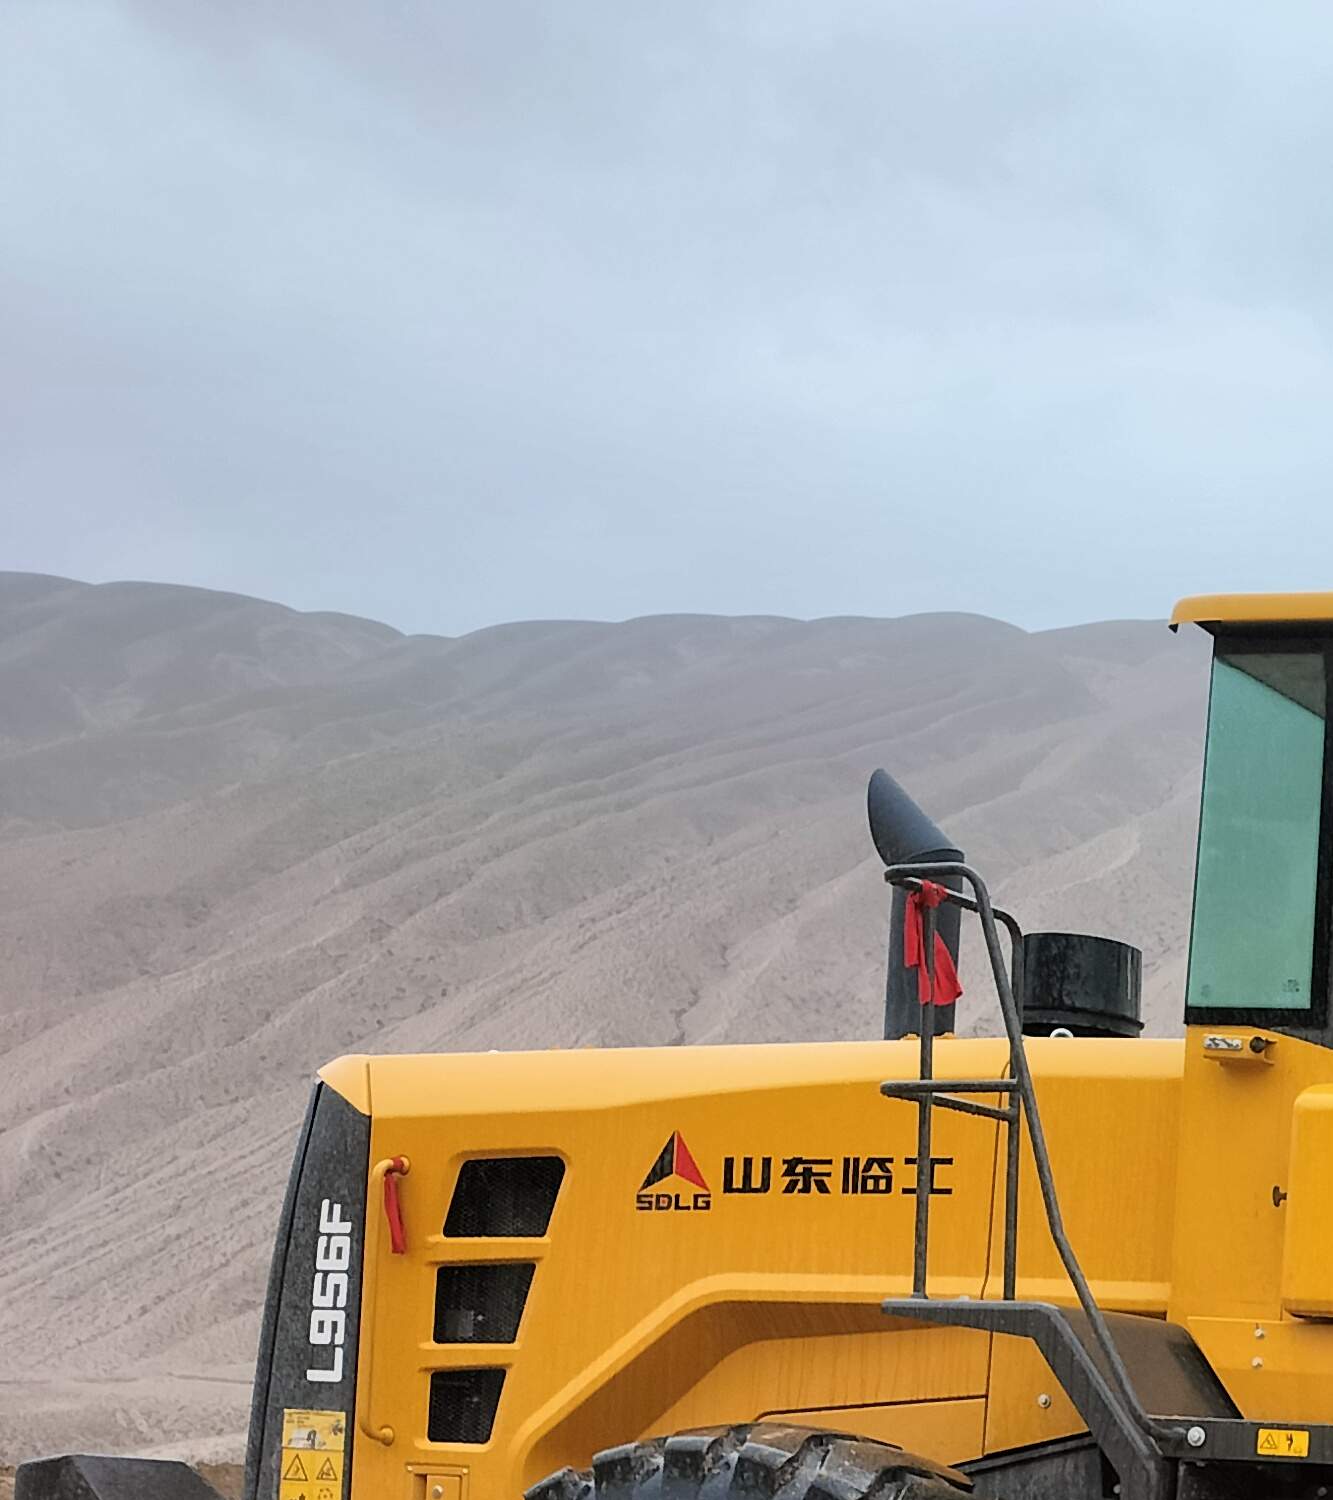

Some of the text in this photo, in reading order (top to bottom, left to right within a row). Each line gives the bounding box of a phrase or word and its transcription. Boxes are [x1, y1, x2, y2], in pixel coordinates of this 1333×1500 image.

[722, 1156, 954, 1195] 山东临工
[636, 1193, 712, 1211] SDLG
[306, 1198, 352, 1382] L956F
